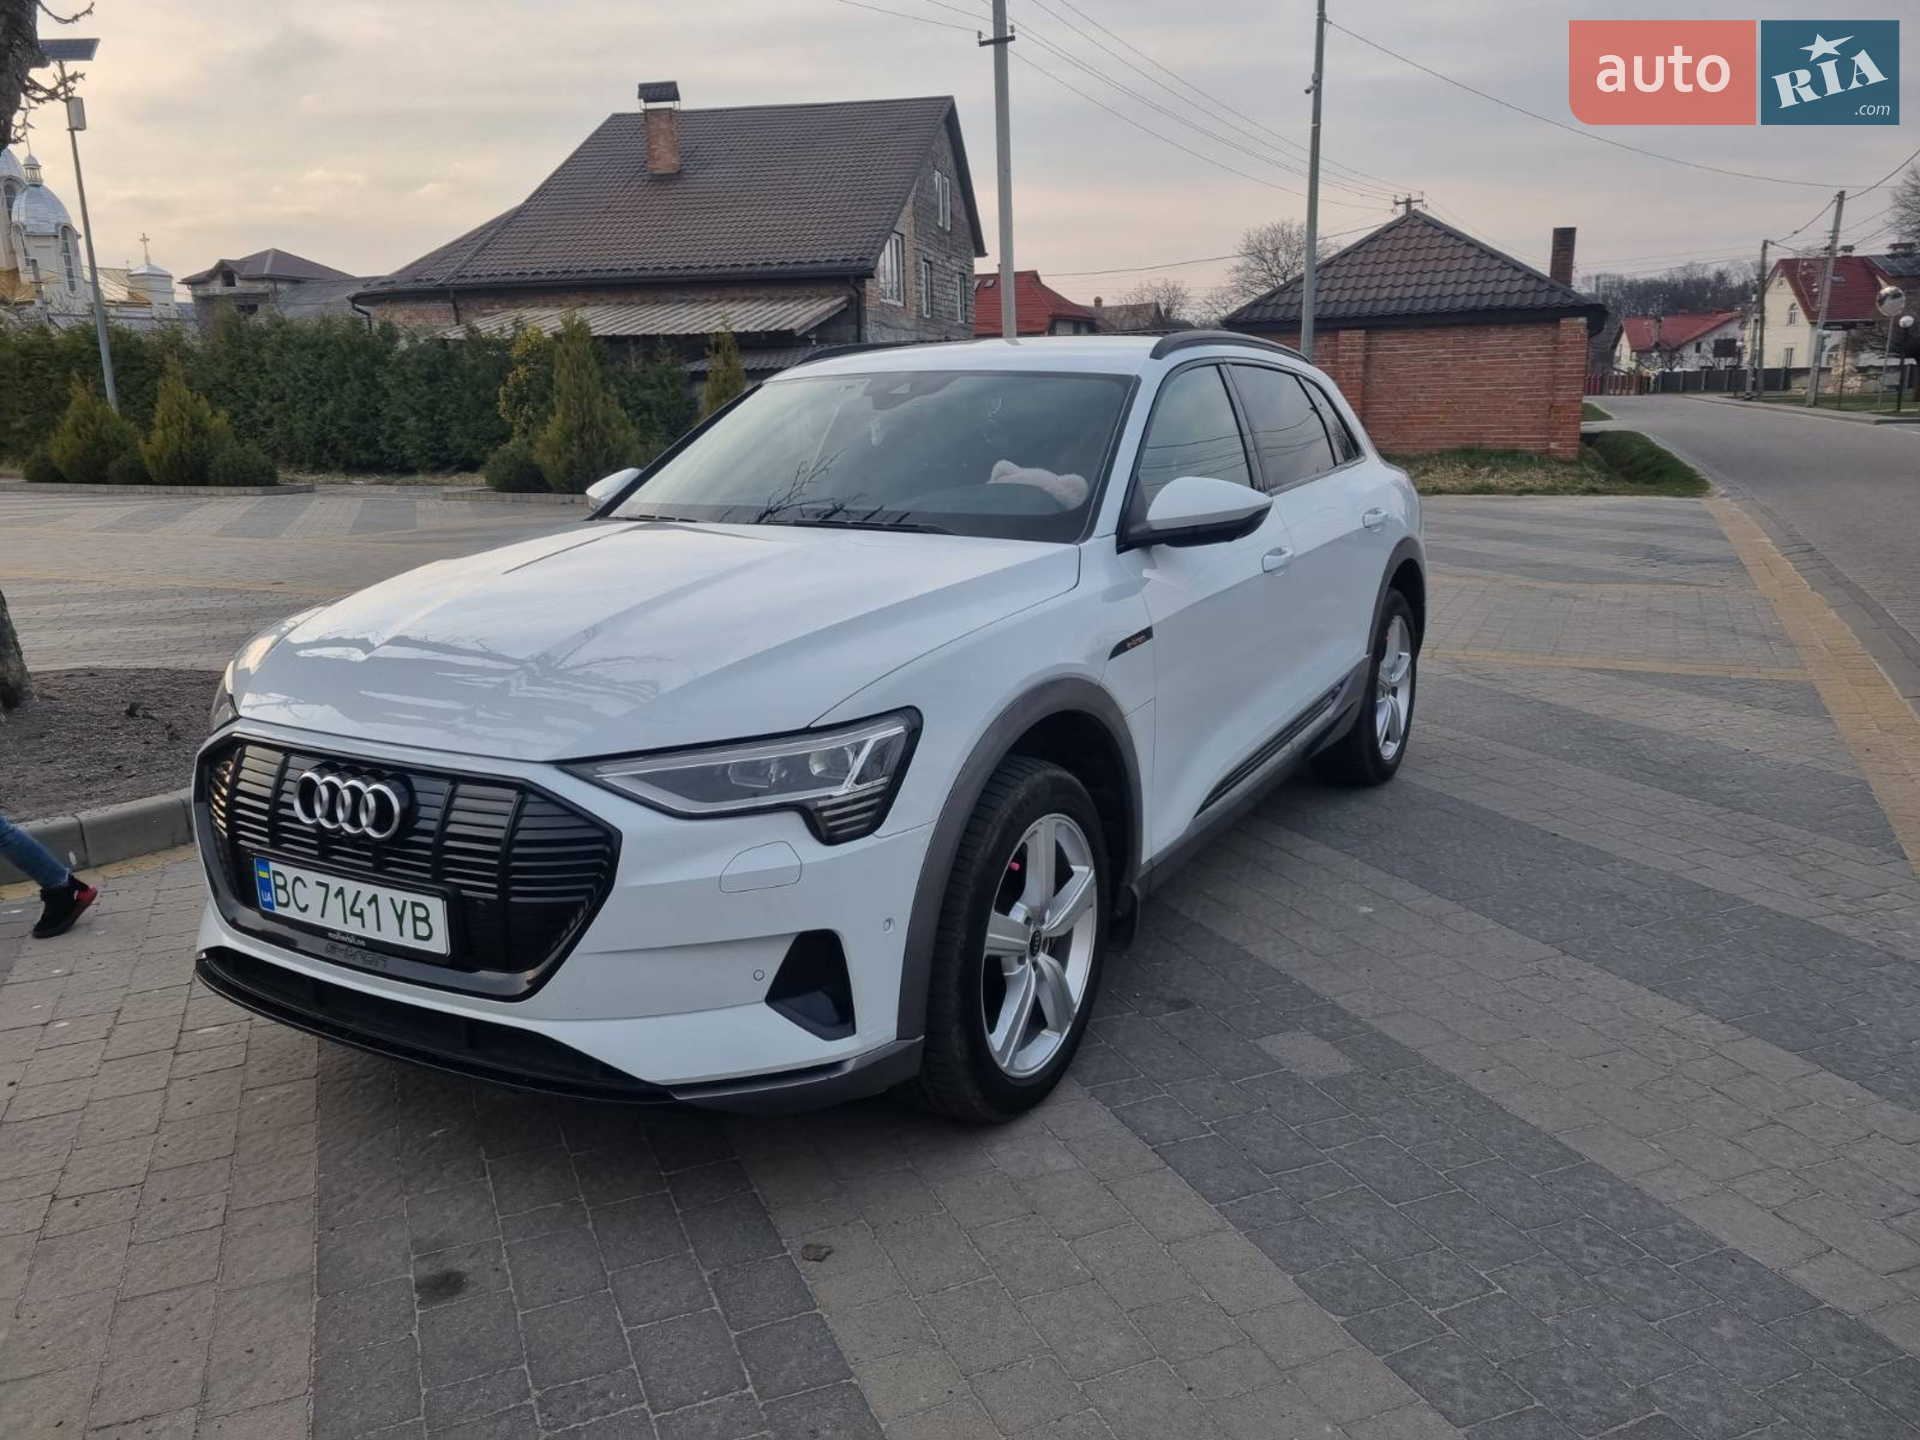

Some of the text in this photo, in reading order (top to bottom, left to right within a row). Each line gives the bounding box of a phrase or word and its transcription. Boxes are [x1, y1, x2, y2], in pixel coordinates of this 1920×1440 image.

[261, 889, 272, 903] UA
[272, 869, 434, 942] BC 7141 YB
